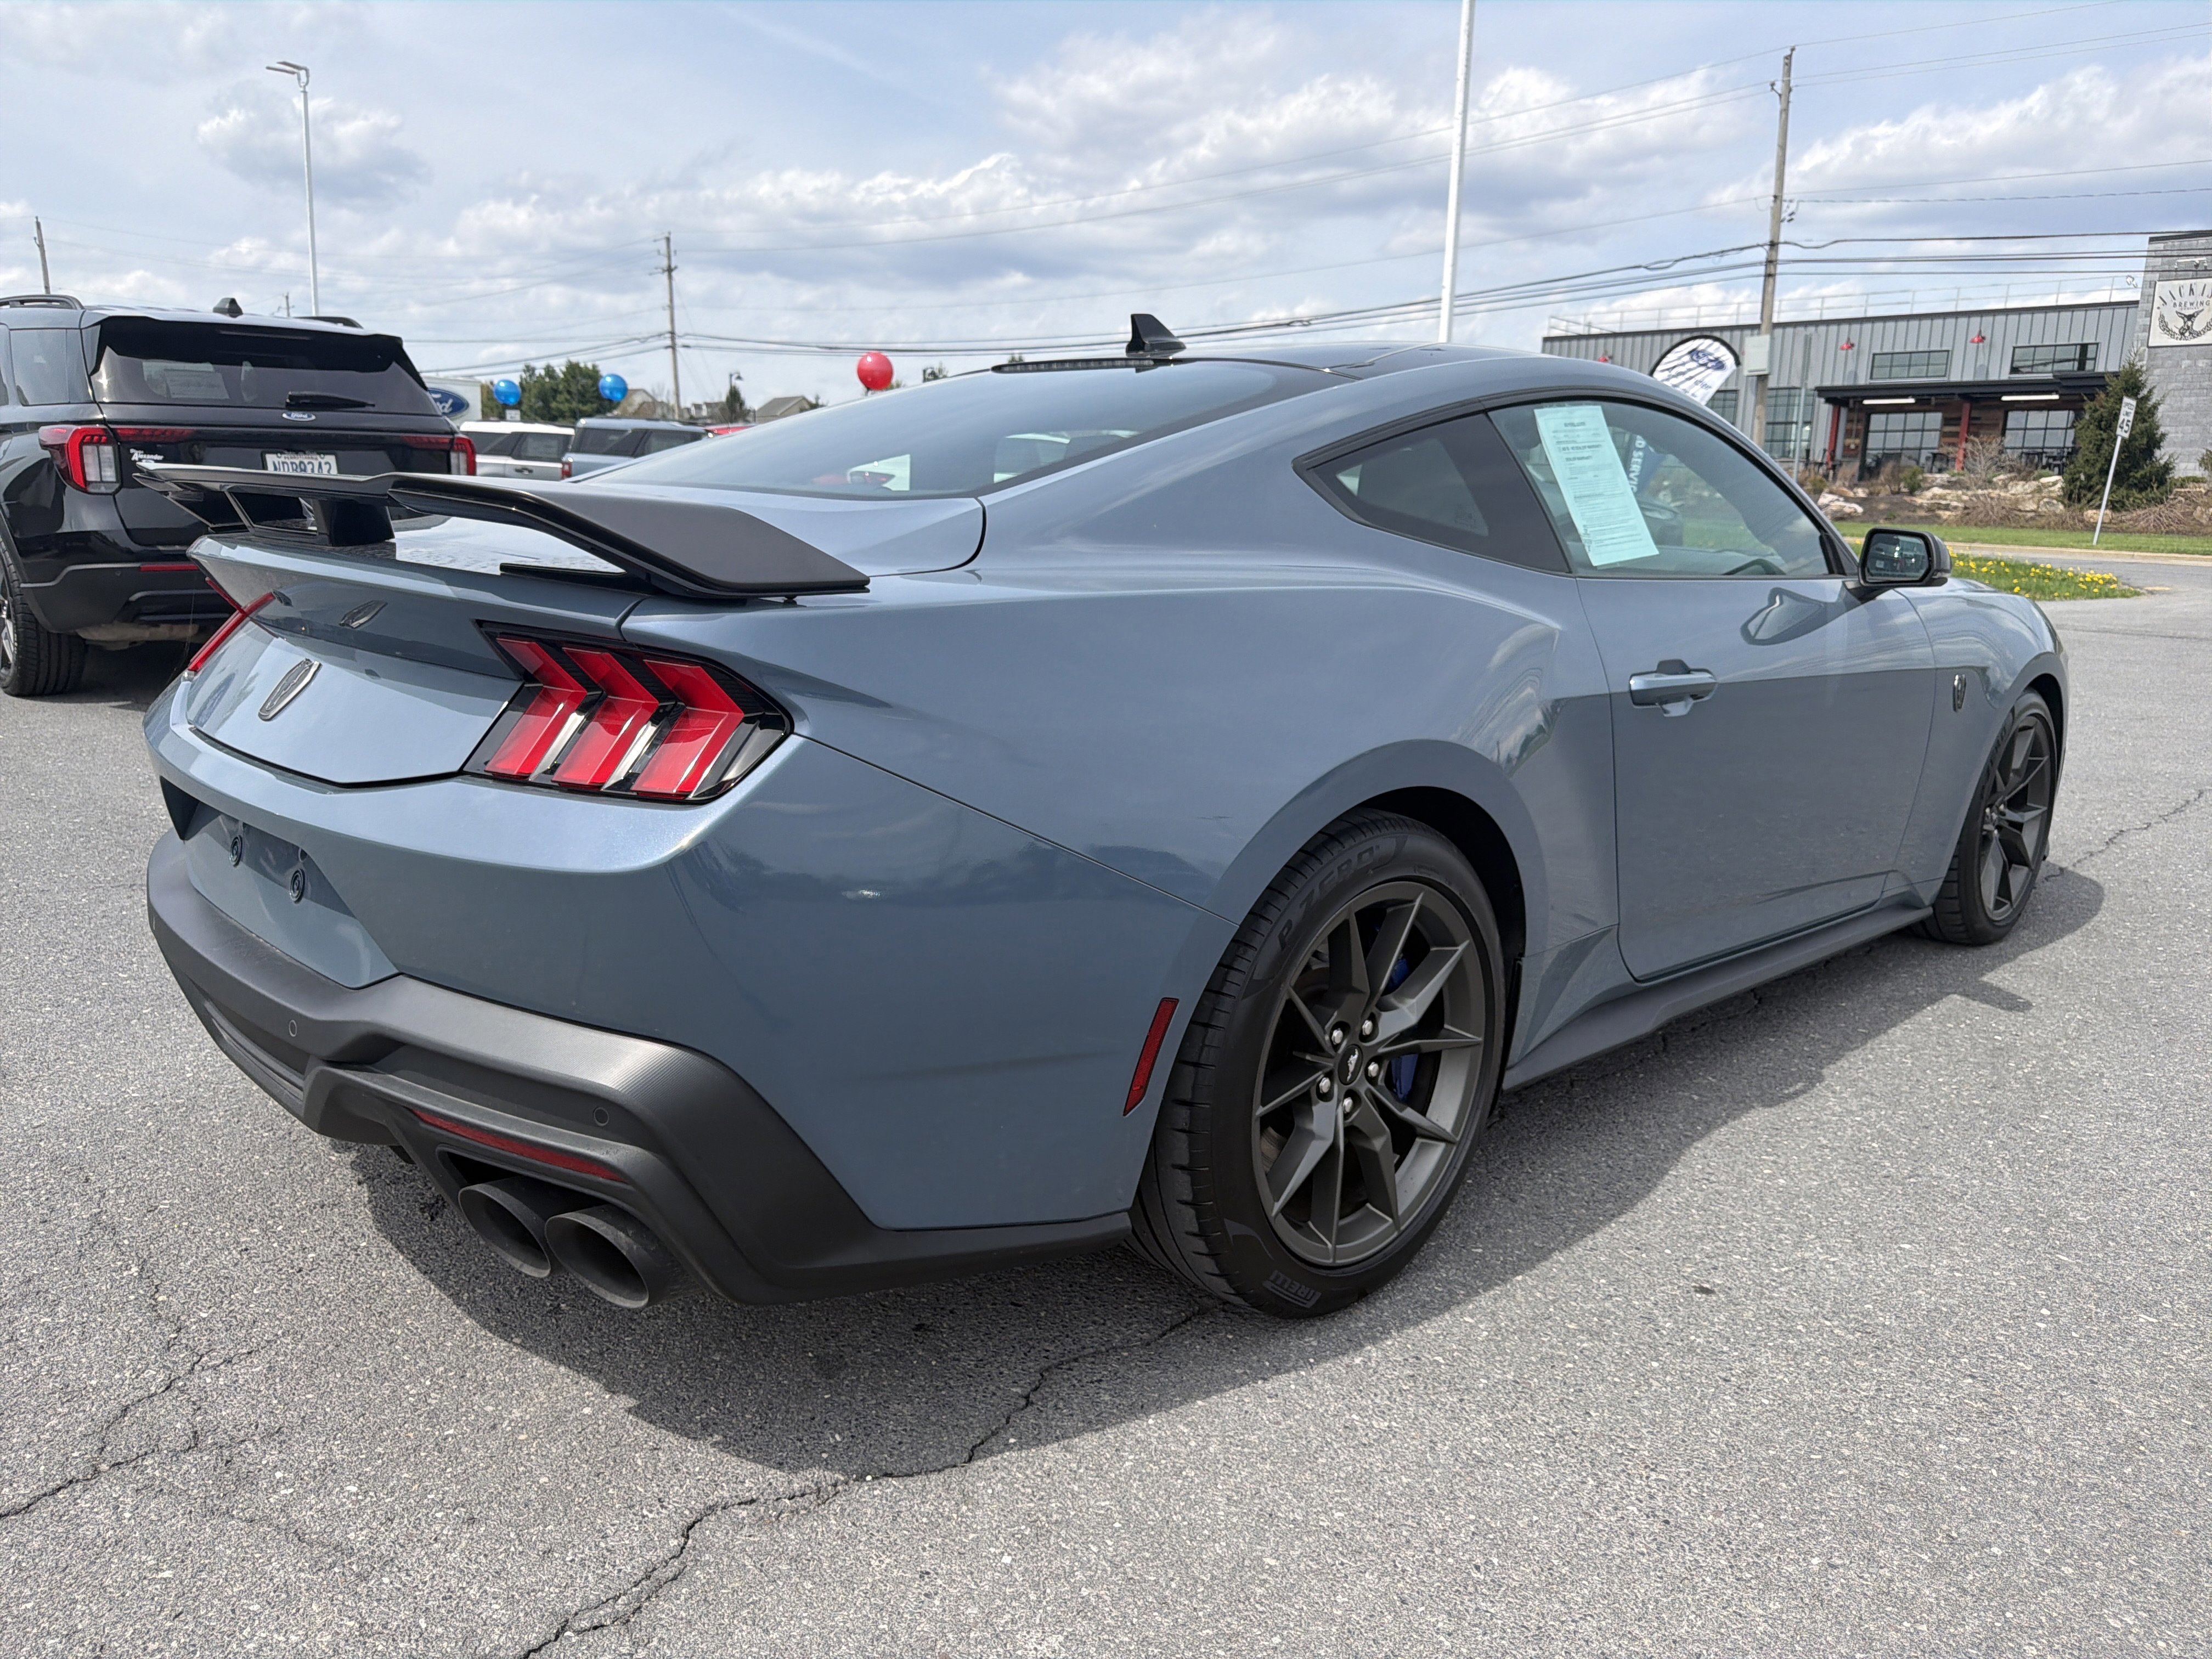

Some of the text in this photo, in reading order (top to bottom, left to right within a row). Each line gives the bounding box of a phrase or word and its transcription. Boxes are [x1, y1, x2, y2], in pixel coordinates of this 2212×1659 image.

[2172, 300, 2210, 308] BREWING
[2119, 417, 2131, 433] 45
[1278, 845, 1374, 952] P ZERO
[1262, 1269, 1322, 1308] PIRELLI
